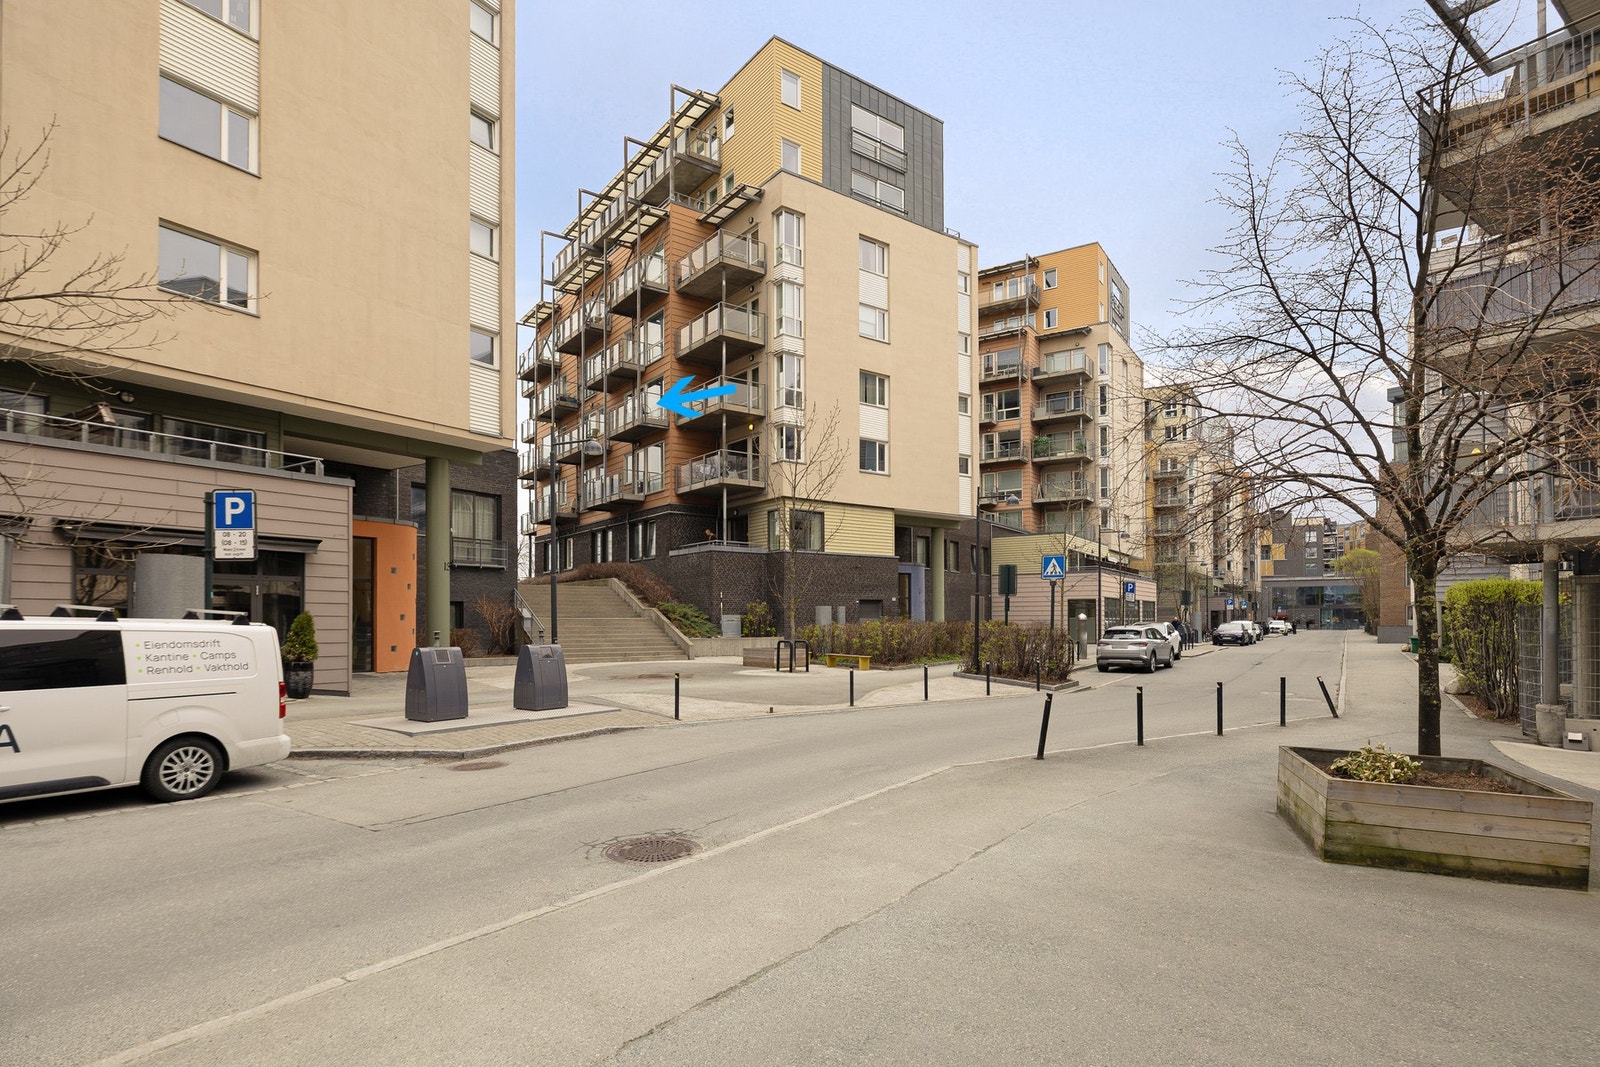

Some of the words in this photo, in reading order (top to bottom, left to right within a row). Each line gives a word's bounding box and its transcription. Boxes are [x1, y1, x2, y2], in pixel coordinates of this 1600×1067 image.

[225, 497, 245, 525] P
[1128, 583, 1134, 592] P
[144, 639, 221, 650] Eiendomsdrift
[145, 653, 190, 662] Kantine
[200, 651, 237, 661] Camps
[146, 664, 193, 675] Renhold
[204, 662, 248, 672] Vakthold
